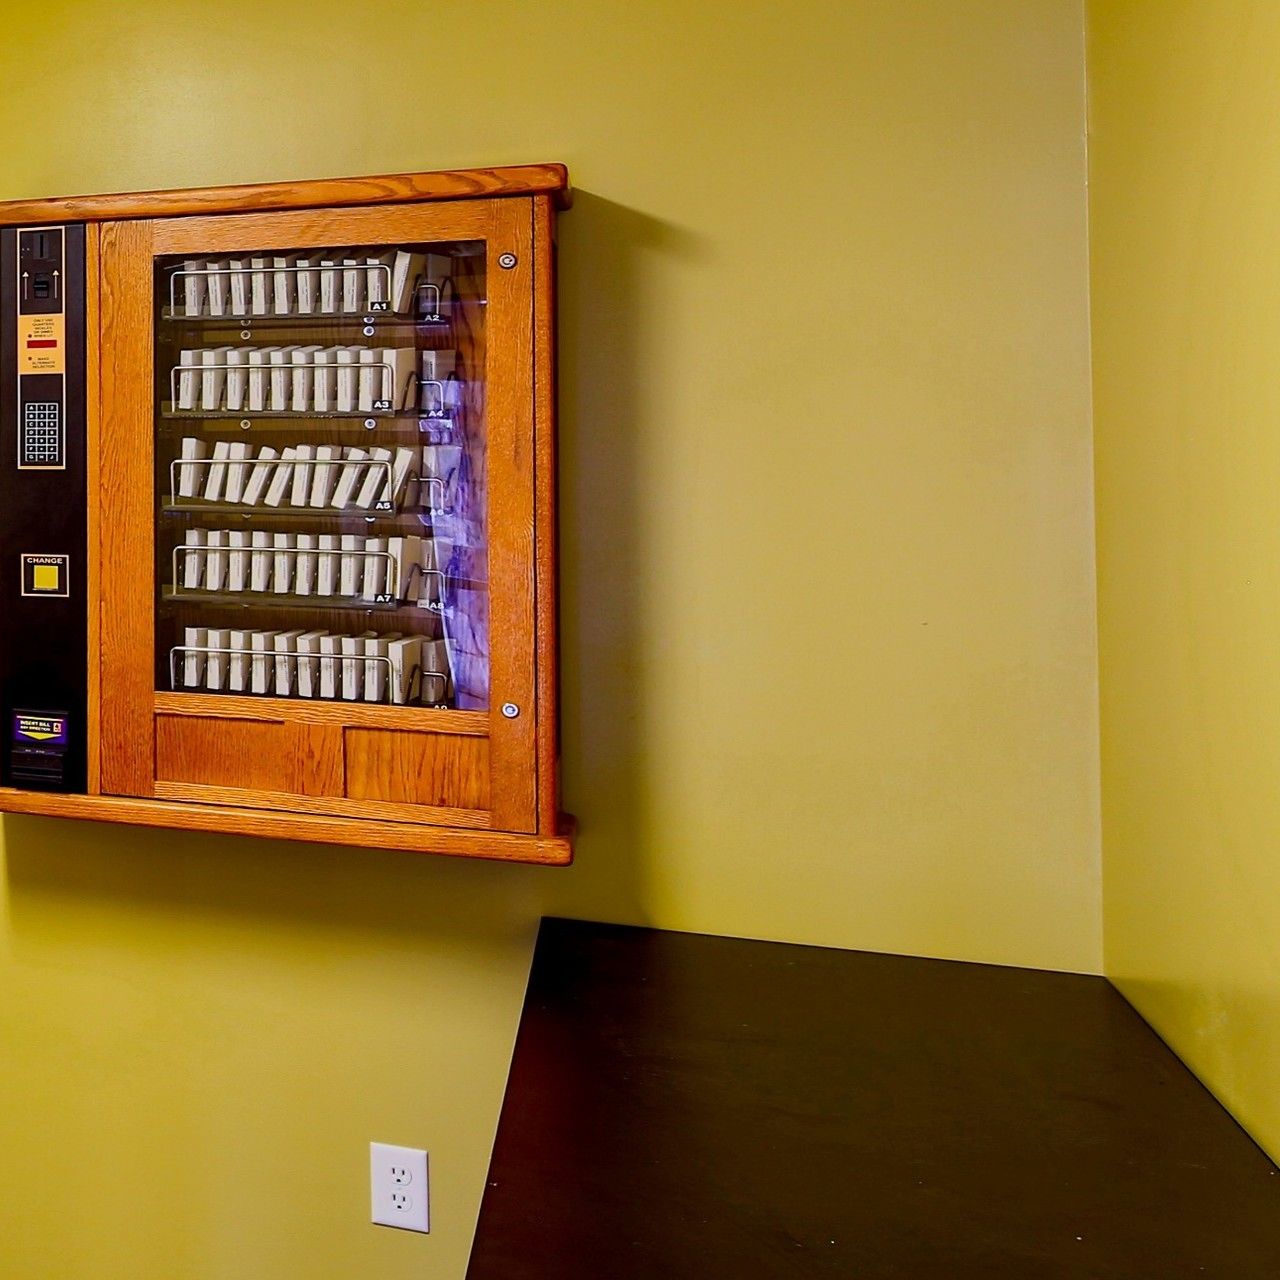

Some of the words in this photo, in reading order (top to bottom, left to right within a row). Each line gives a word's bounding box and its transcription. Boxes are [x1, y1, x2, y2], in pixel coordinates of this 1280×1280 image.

[373, 302, 387, 310] A1
[424, 314, 440, 322] A2
[375, 502, 391, 510] A5
[376, 594, 391, 602] A7
